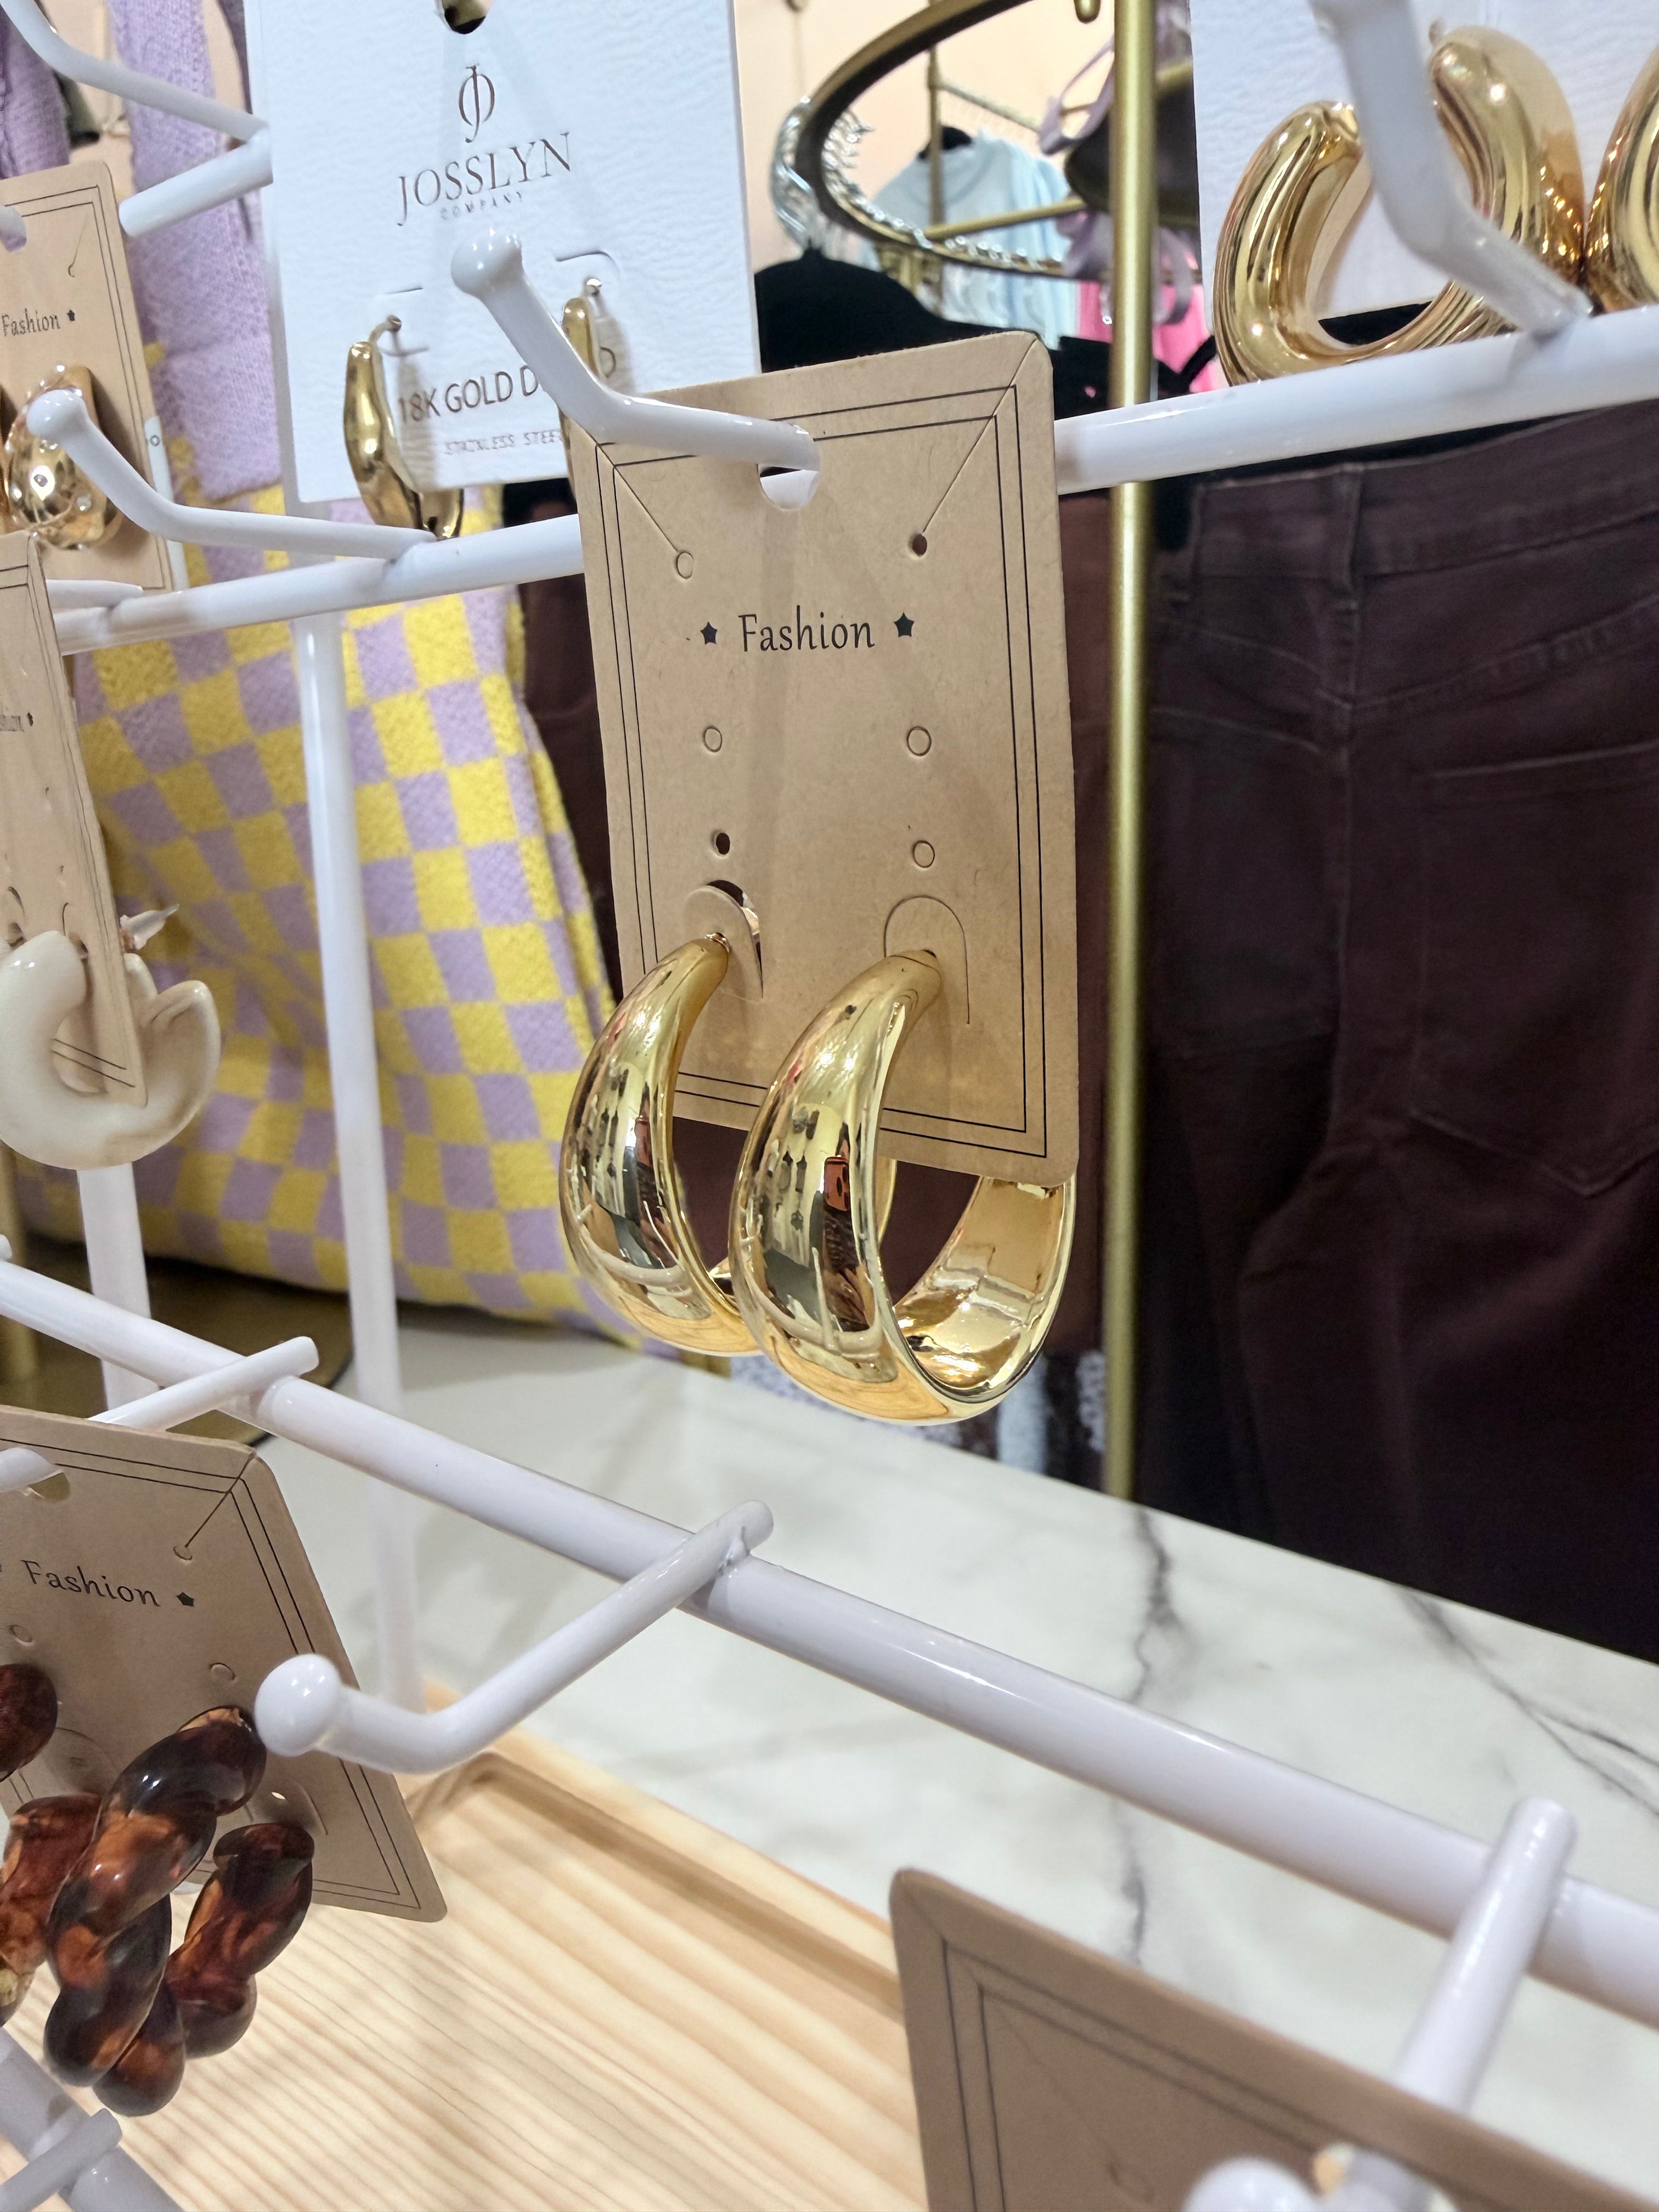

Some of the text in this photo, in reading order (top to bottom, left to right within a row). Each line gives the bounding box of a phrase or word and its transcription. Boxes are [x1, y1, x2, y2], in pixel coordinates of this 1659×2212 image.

[397, 132, 571, 226] JOSSLYN
[2, 308, 61, 337] Fashion
[399, 371, 514, 424] 18K GOLD
[523, 430, 561, 445] STEE
[738, 605, 875, 652] Fashion
[21, 1560, 162, 1607] Fashion
